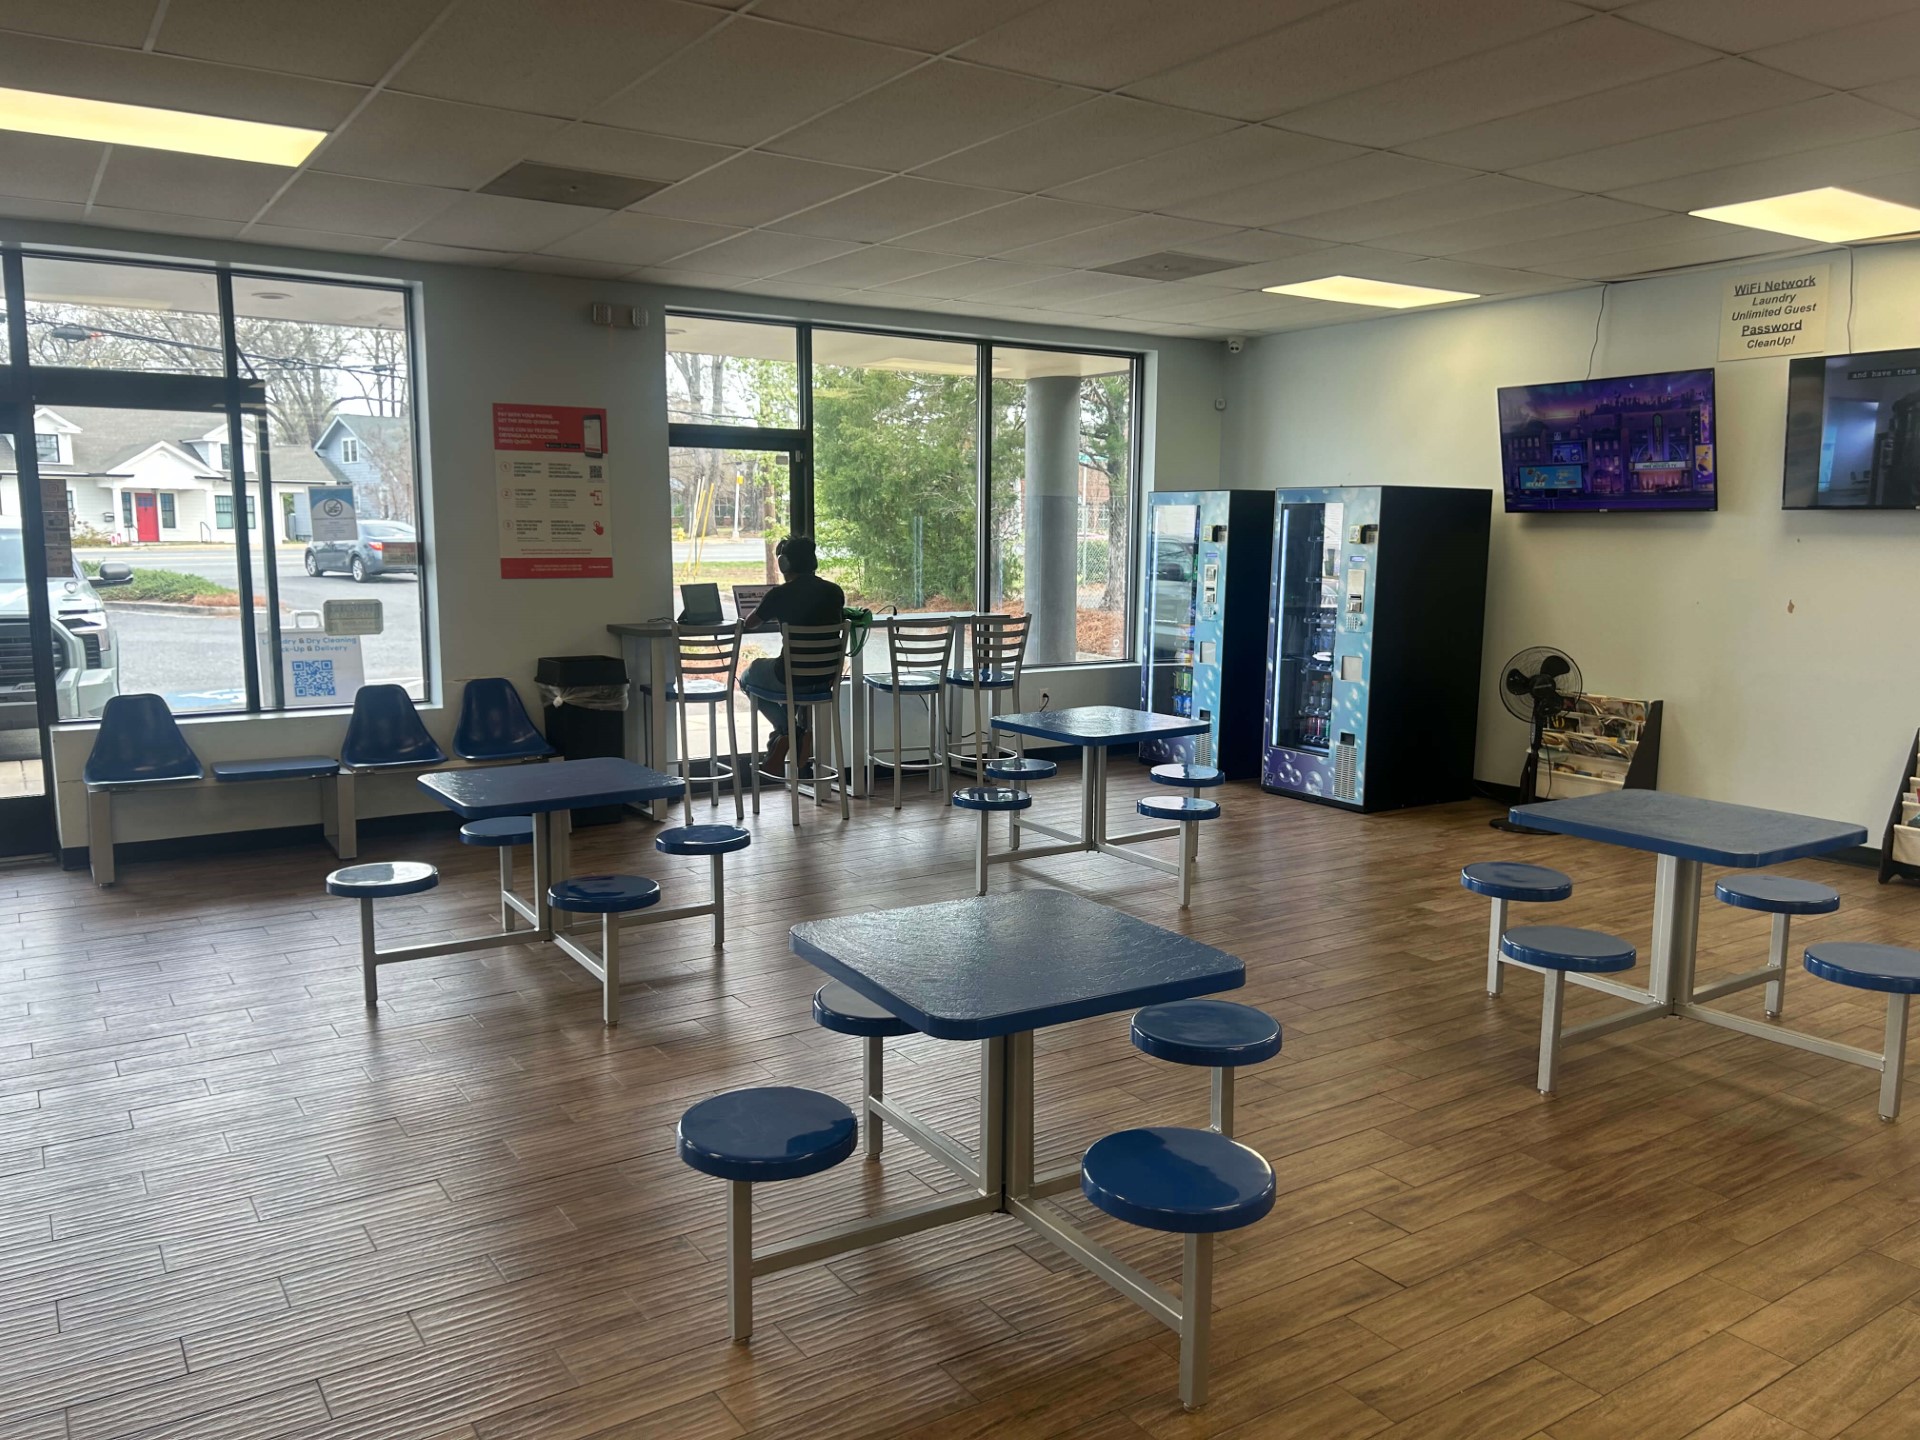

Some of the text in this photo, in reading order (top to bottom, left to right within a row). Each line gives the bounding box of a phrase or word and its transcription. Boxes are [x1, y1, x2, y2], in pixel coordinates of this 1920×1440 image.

[1734, 276, 1816, 297] WiFi Network
[1752, 293, 1797, 306] Laundry
[1732, 303, 1817, 321] Unlimited Guest
[1741, 319, 1802, 337] Password
[1747, 335, 1796, 349] CleanUp!
[1852, 368, 1916, 379] and have them
[323, 636, 357, 645] Cleaning
[314, 645, 348, 653] Delivery
